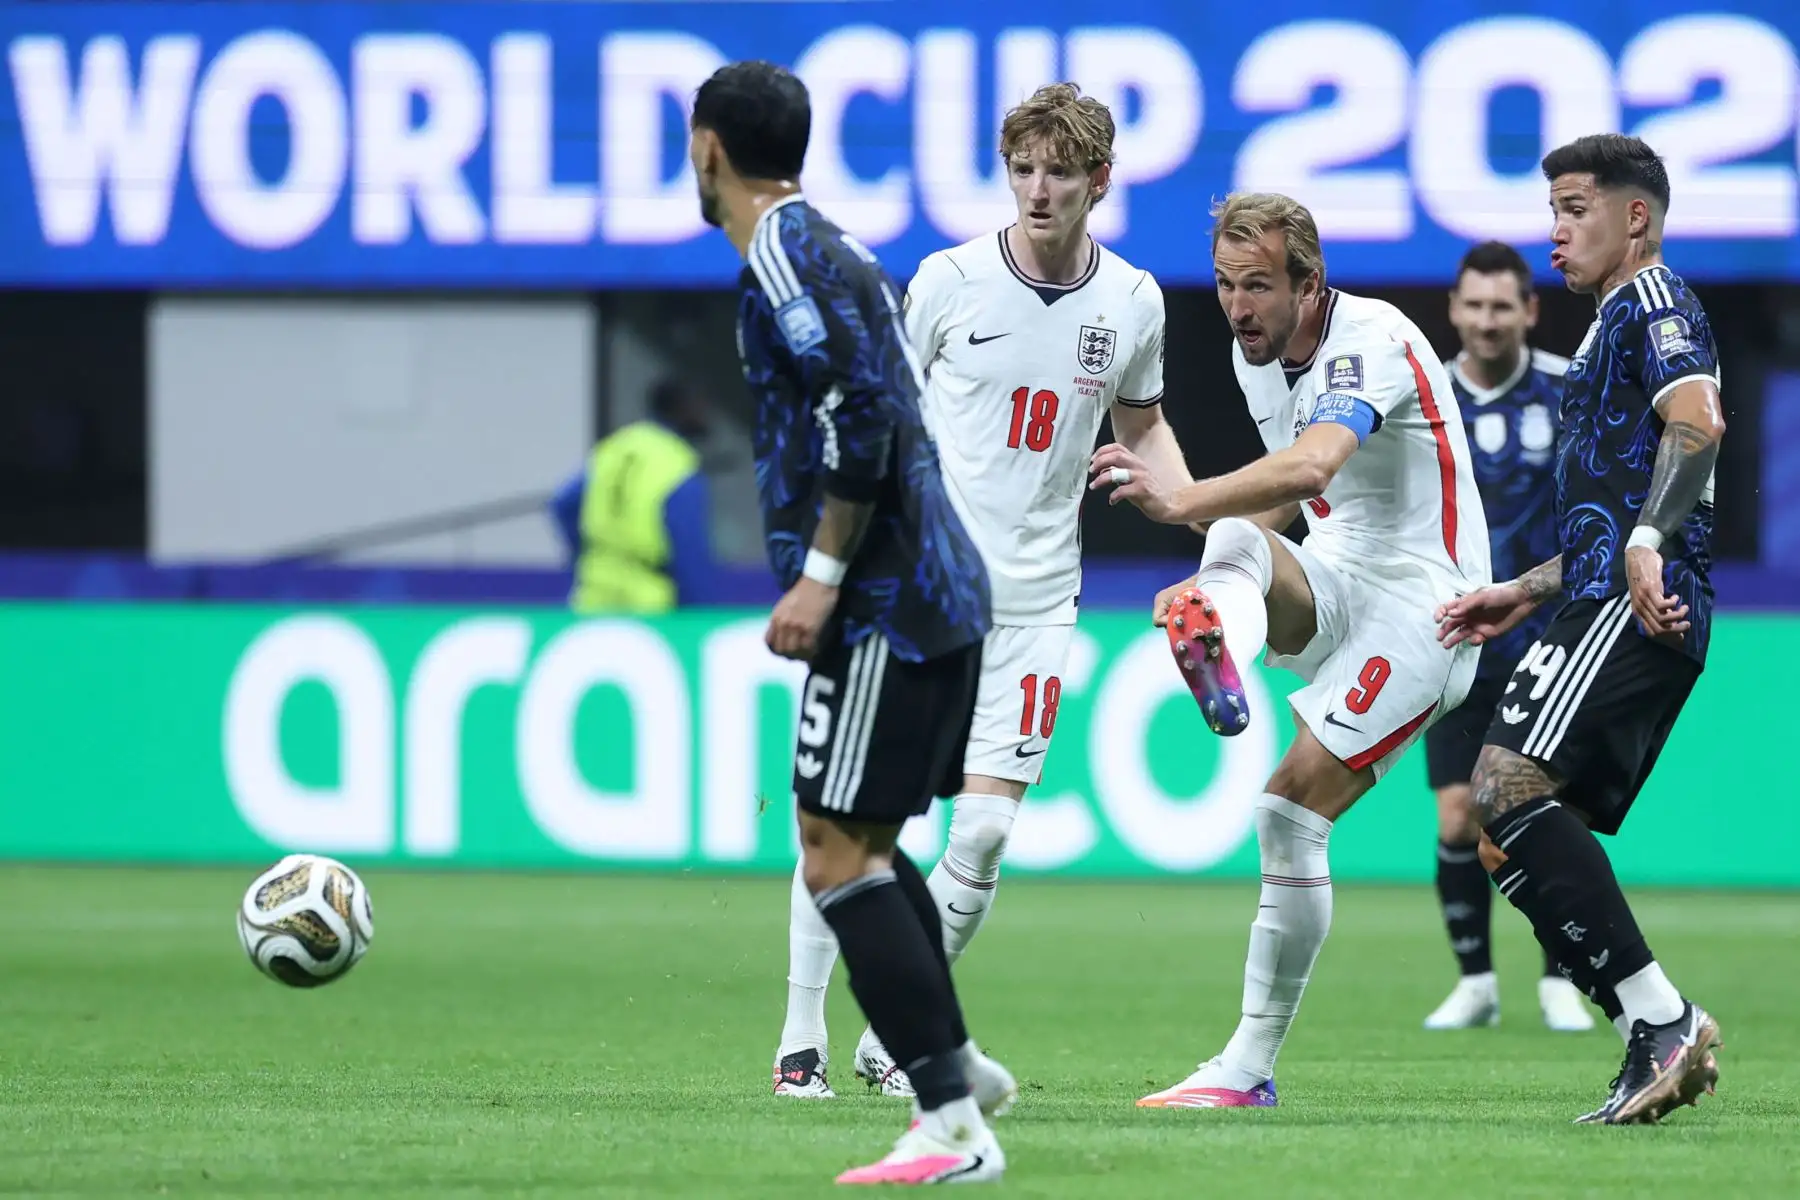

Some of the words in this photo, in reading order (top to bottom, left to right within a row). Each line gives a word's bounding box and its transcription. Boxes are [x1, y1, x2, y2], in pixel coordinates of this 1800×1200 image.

[8, 28, 731, 250] WORLD
[797, 25, 1204, 245] CUP
[1234, 14, 1800, 242] 202
[1073, 376, 1107, 389] ARGENTINA
[1007, 386, 1060, 452] 18
[800, 673, 836, 748] 5
[1020, 673, 1061, 739] 18
[1345, 655, 1392, 715] 9
